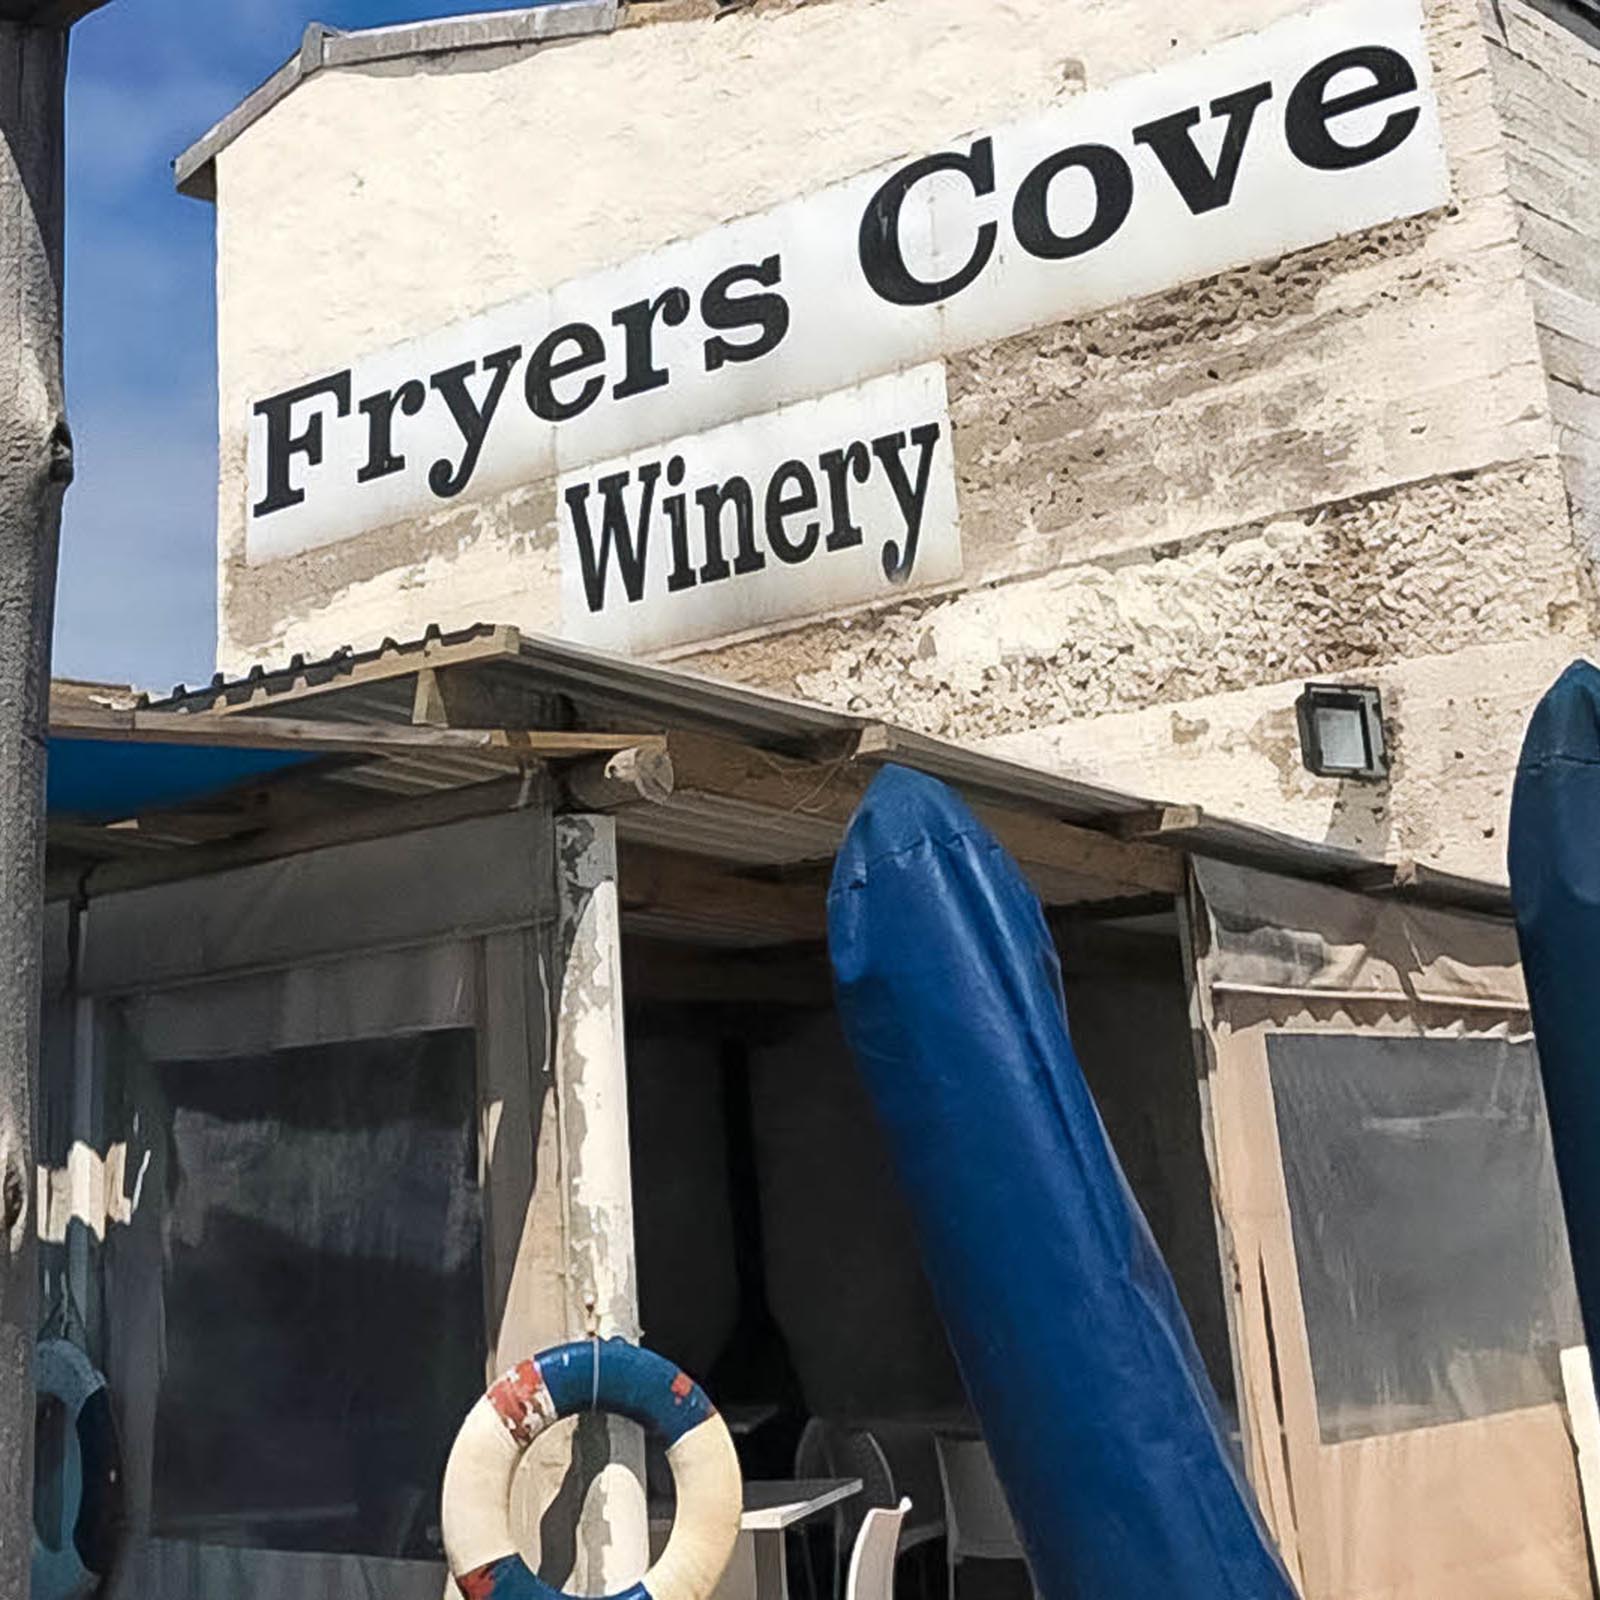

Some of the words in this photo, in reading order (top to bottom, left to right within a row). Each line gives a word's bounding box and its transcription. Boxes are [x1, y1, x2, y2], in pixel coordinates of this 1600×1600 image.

[253, 254, 789, 518] Fryers
[858, 44, 1421, 306] Cove
[565, 421, 940, 613] Winery
